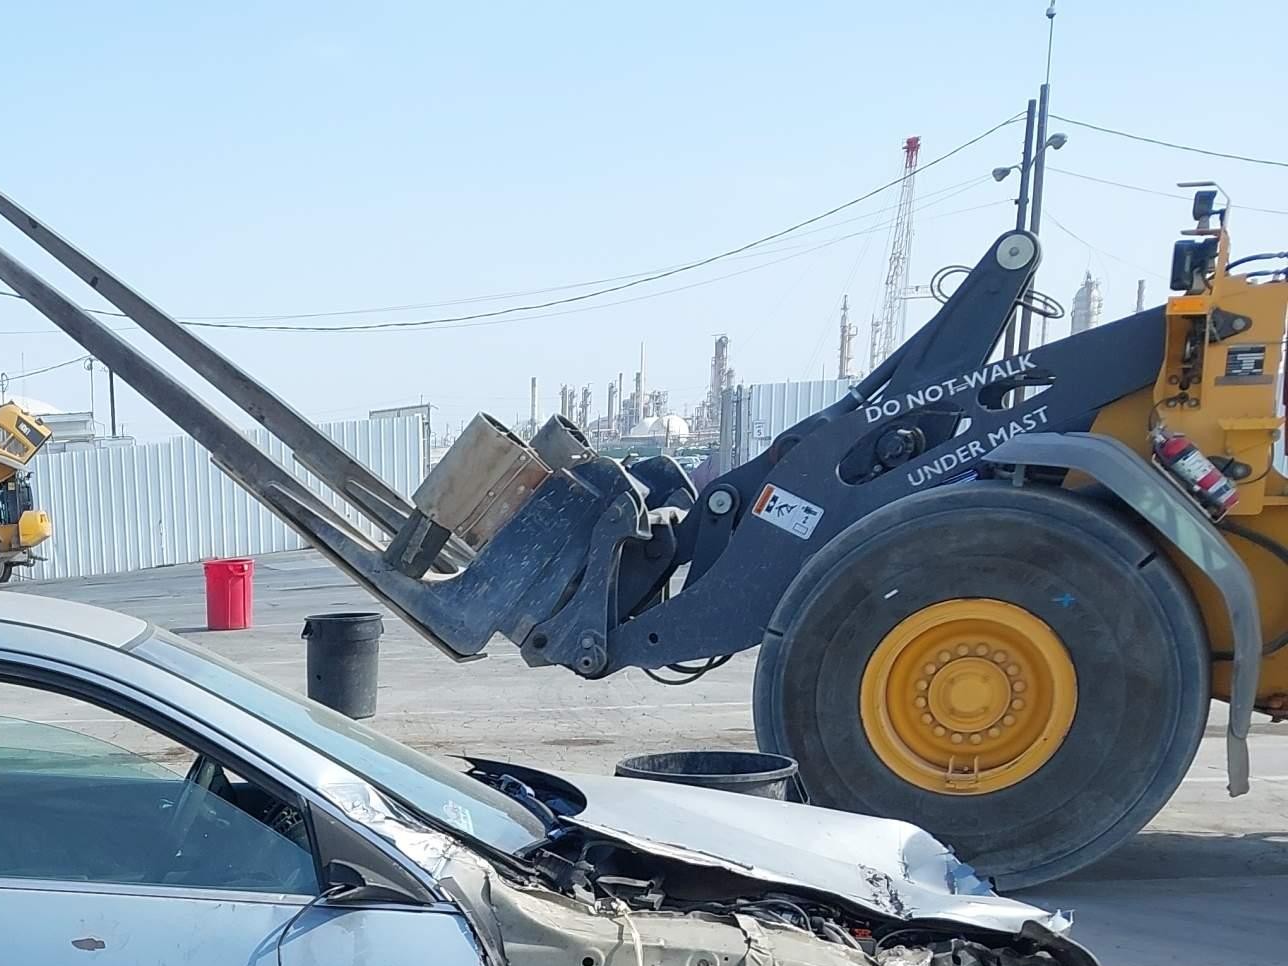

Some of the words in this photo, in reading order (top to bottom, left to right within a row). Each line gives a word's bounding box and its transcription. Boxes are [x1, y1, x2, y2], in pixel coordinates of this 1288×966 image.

[865, 399, 901, 423] DO
[906, 378, 958, 409] NOT
[964, 353, 1037, 388] WALK
[907, 440, 986, 486] UNDER
[987, 405, 1049, 447] MAST
